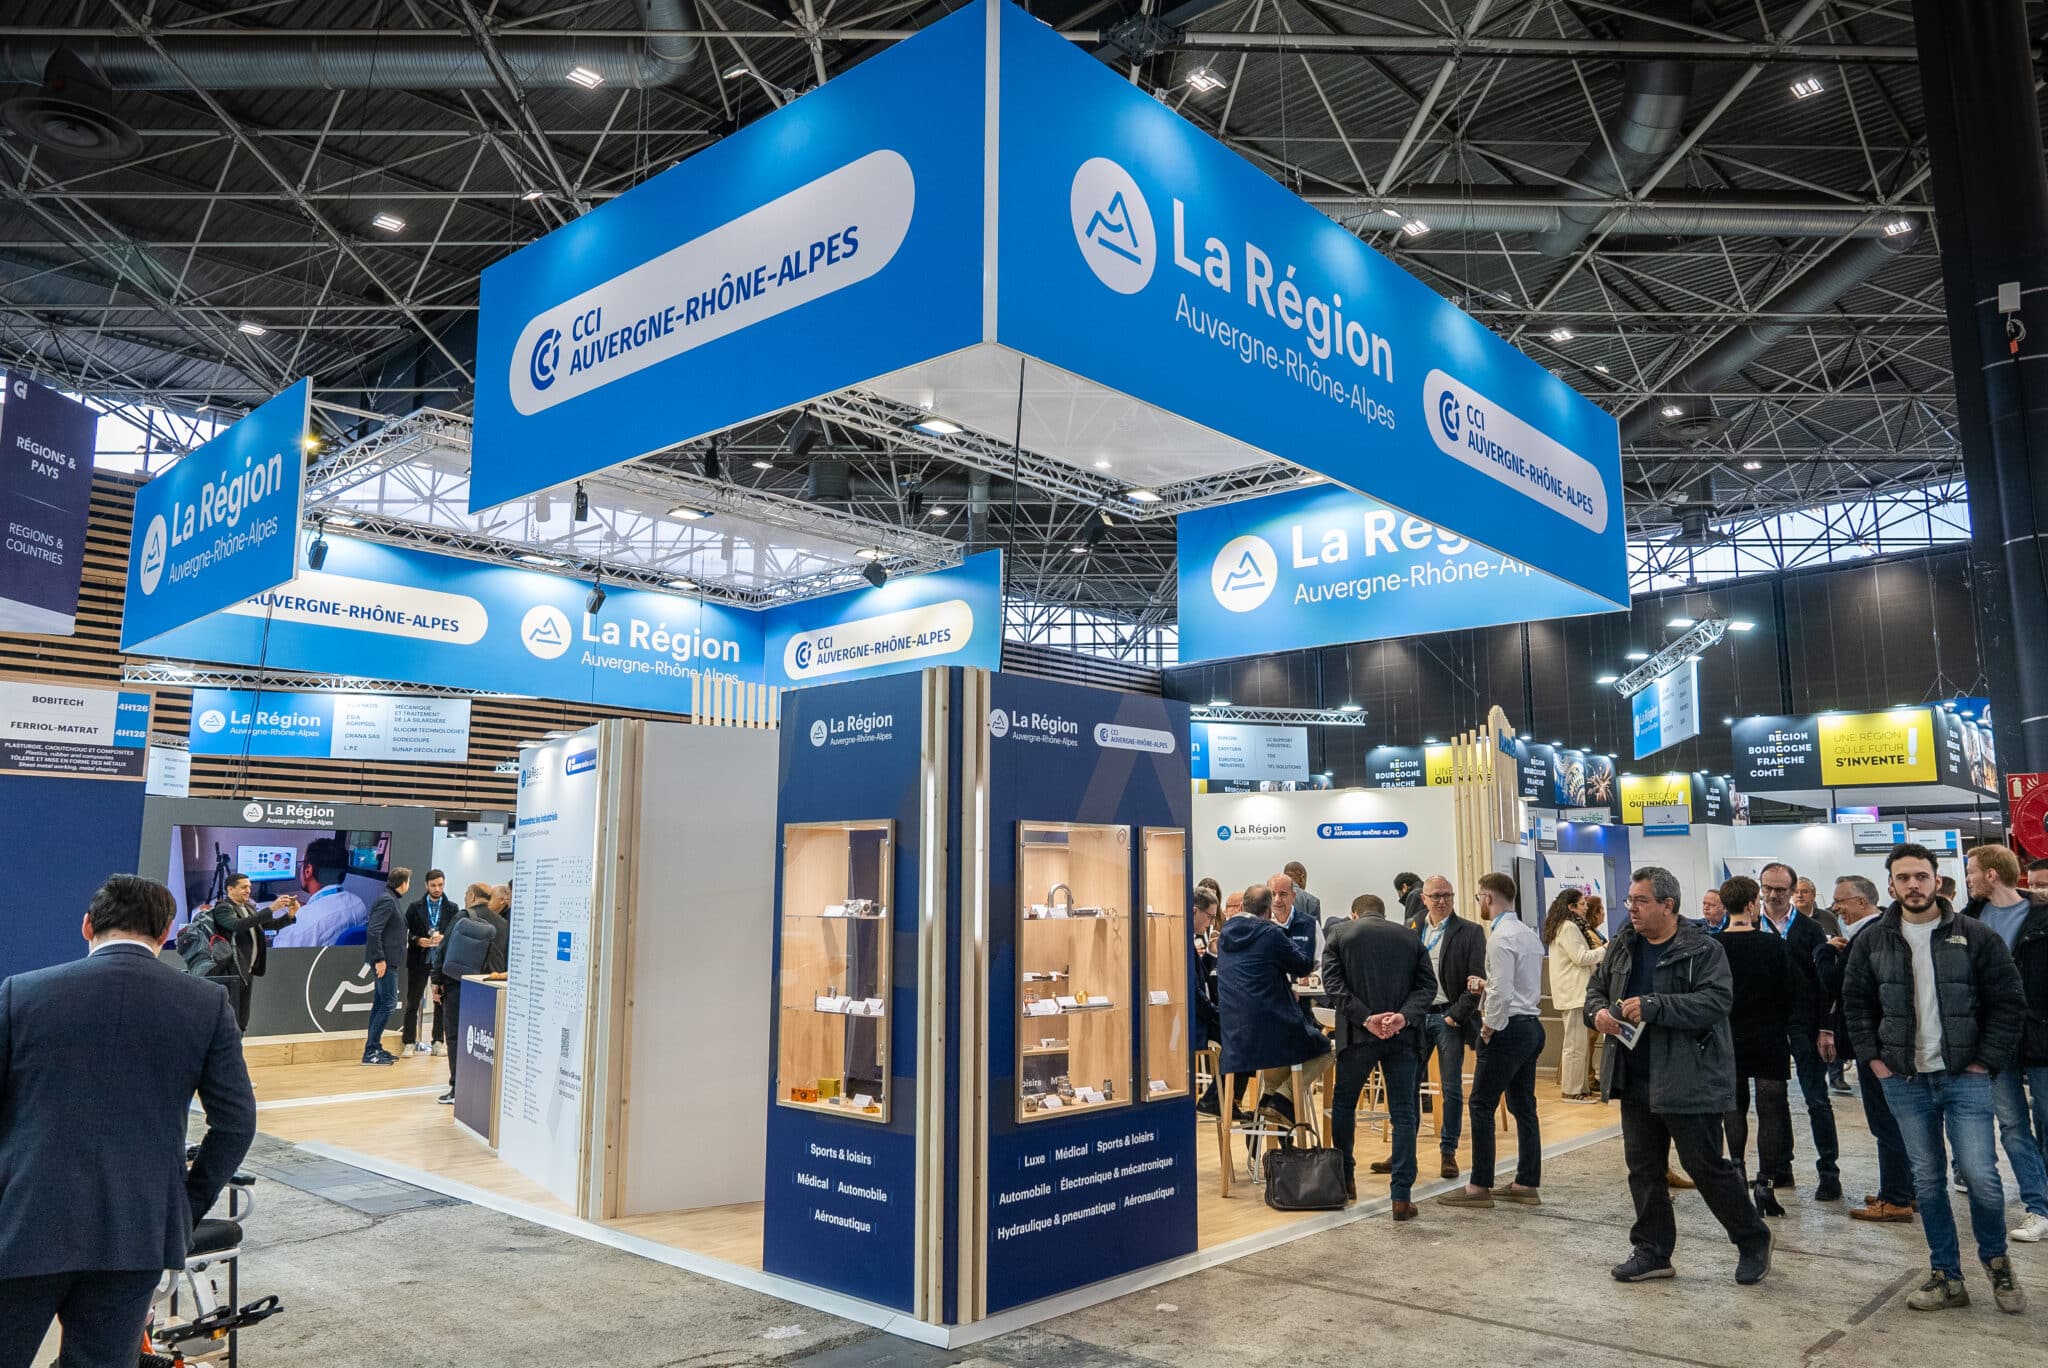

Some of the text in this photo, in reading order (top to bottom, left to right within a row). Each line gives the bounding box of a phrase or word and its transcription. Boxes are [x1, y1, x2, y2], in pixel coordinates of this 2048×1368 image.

[569, 225, 859, 376] AUVERGNE-RHÔNE-ALPES
[1173, 197, 1393, 384] La Région
[572, 307, 601, 343] CCI
[1176, 292, 1395, 430] Auvergne-Rhône-Alpes
[1467, 404, 1485, 431] CCI
[16, 436, 76, 470] RÉGIONS &
[31, 459, 59, 480] PAYS
[1467, 431, 1593, 516] AUVERGNE-RHÔNE-ALPES
[171, 453, 282, 548] La Région
[9, 522, 63, 550] REGIONS &
[1291, 525, 1349, 569] La
[6, 538, 63, 565] COUNTRIES
[168, 515, 278, 585] Auvergne-Rhône-Alpes
[582, 611, 740, 662] La Région
[817, 636, 833, 649] CCI
[817, 628, 951, 665] AUVERGNE-RHÔNE-ALPES
[32, 696, 84, 706] BOBITECH
[11, 721, 98, 734] FERRIOL-MATRAT
[231, 711, 320, 728] La Région
[830, 711, 893, 734] La Région
[1012, 710, 1078, 735] La Région
[830, 732, 892, 747] Auvergne-Rhône-Alpes
[1012, 732, 1078, 748] Auvergne-Rhône-Alpes
[1834, 730, 1902, 742] UNE RÉGION
[1748, 744, 1812, 754] BOURGOGNE
[1757, 756, 1804, 766] FRANCHE
[1854, 746, 1866, 754] LE
[1868, 744, 1904, 752] FUTUR
[1375, 770, 1420, 780] BOURGOGNE
[267, 804, 334, 818] La Région
[1234, 824, 1286, 836] La Région
[1055, 1143, 1088, 1161] Médical
[1097, 1130, 1154, 1154] Sports & loisirs
[810, 1143, 872, 1166] Sports & loisirs
[1024, 1153, 1046, 1168] Luxe
[797, 1172, 829, 1190] Médical
[1060, 1154, 1173, 1191] Électronique & mécatronique
[838, 1180, 888, 1202] Automobile
[999, 1181, 1051, 1206] Automobile
[1124, 1184, 1174, 1208] Aéronautique
[814, 1208, 872, 1234] Aéronautique
[997, 1199, 1116, 1241] Hydraulique & pneumatique
